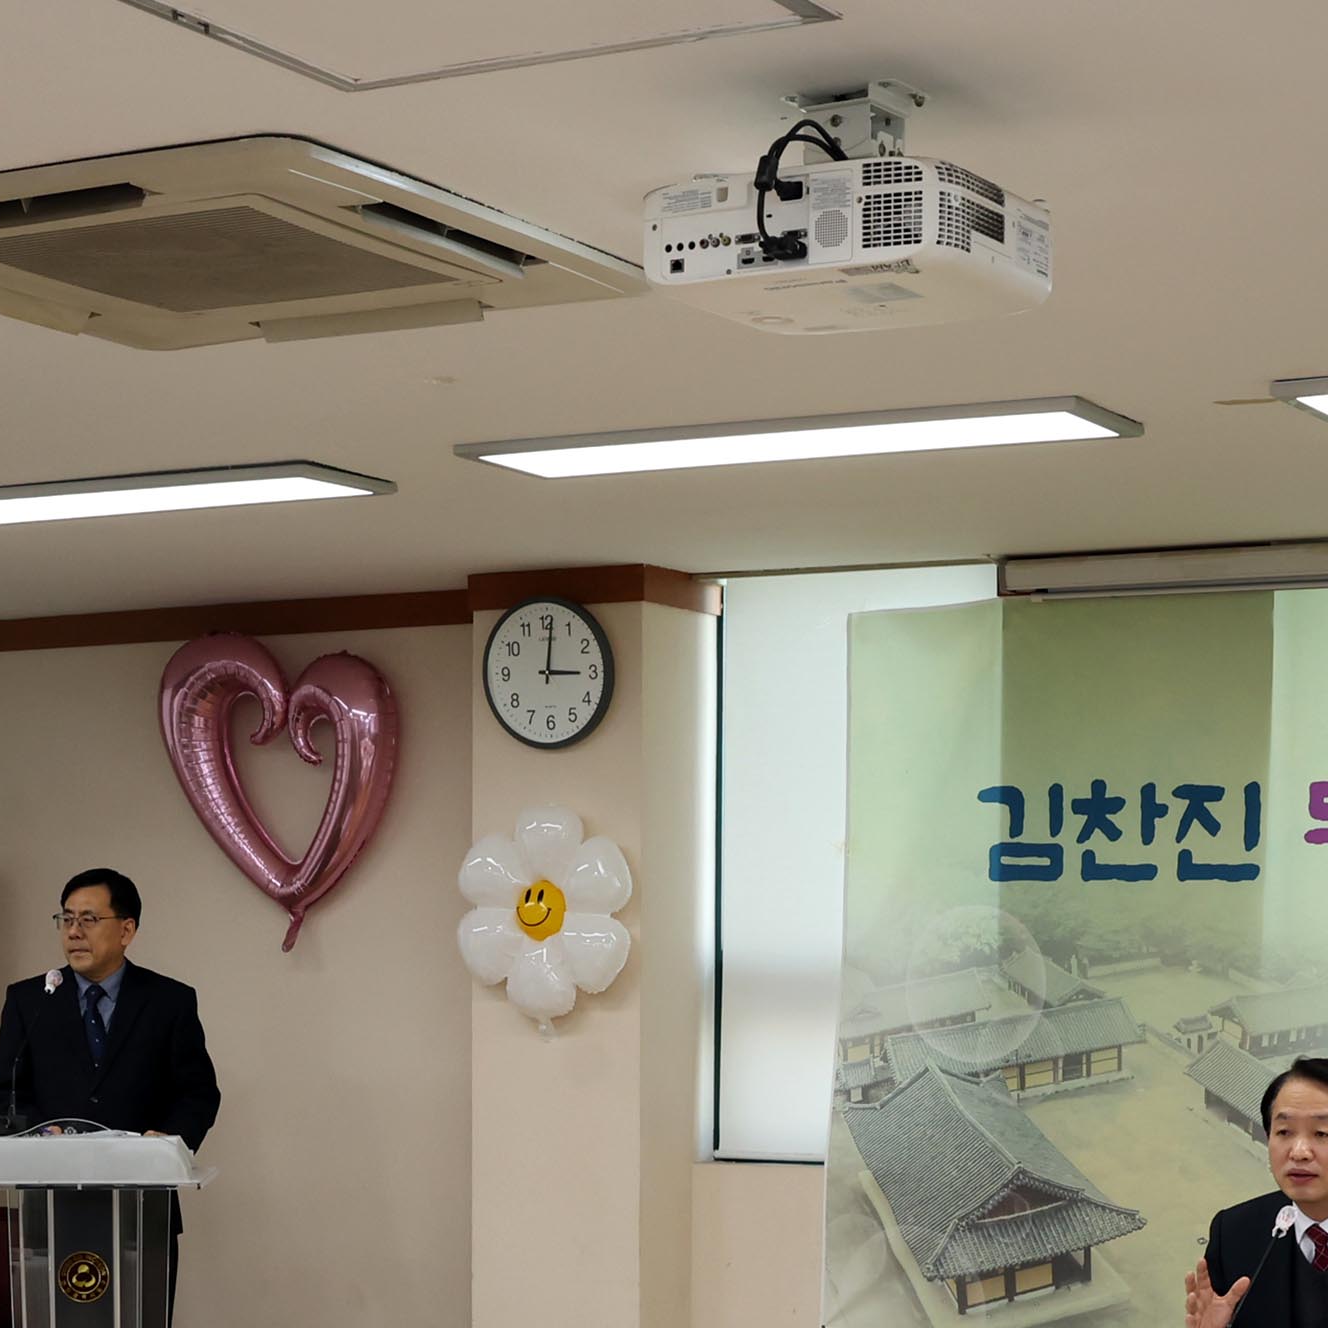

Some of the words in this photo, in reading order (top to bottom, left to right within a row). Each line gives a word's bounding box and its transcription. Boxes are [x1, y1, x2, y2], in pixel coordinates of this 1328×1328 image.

[520, 622, 531, 637] 11
[539, 614, 554, 631] 12
[565, 621, 572, 637] 1
[505, 641, 520, 657] 10
[580, 638, 590, 654] 2
[501, 666, 511, 682] 9
[588, 664, 598, 680] 3
[510, 692, 520, 708] 8
[582, 691, 592, 706] 4
[526, 709, 536, 725] 7
[546, 714, 556, 731] 6
[568, 707, 578, 723] 5
[977, 778, 1262, 883] 김찬진
